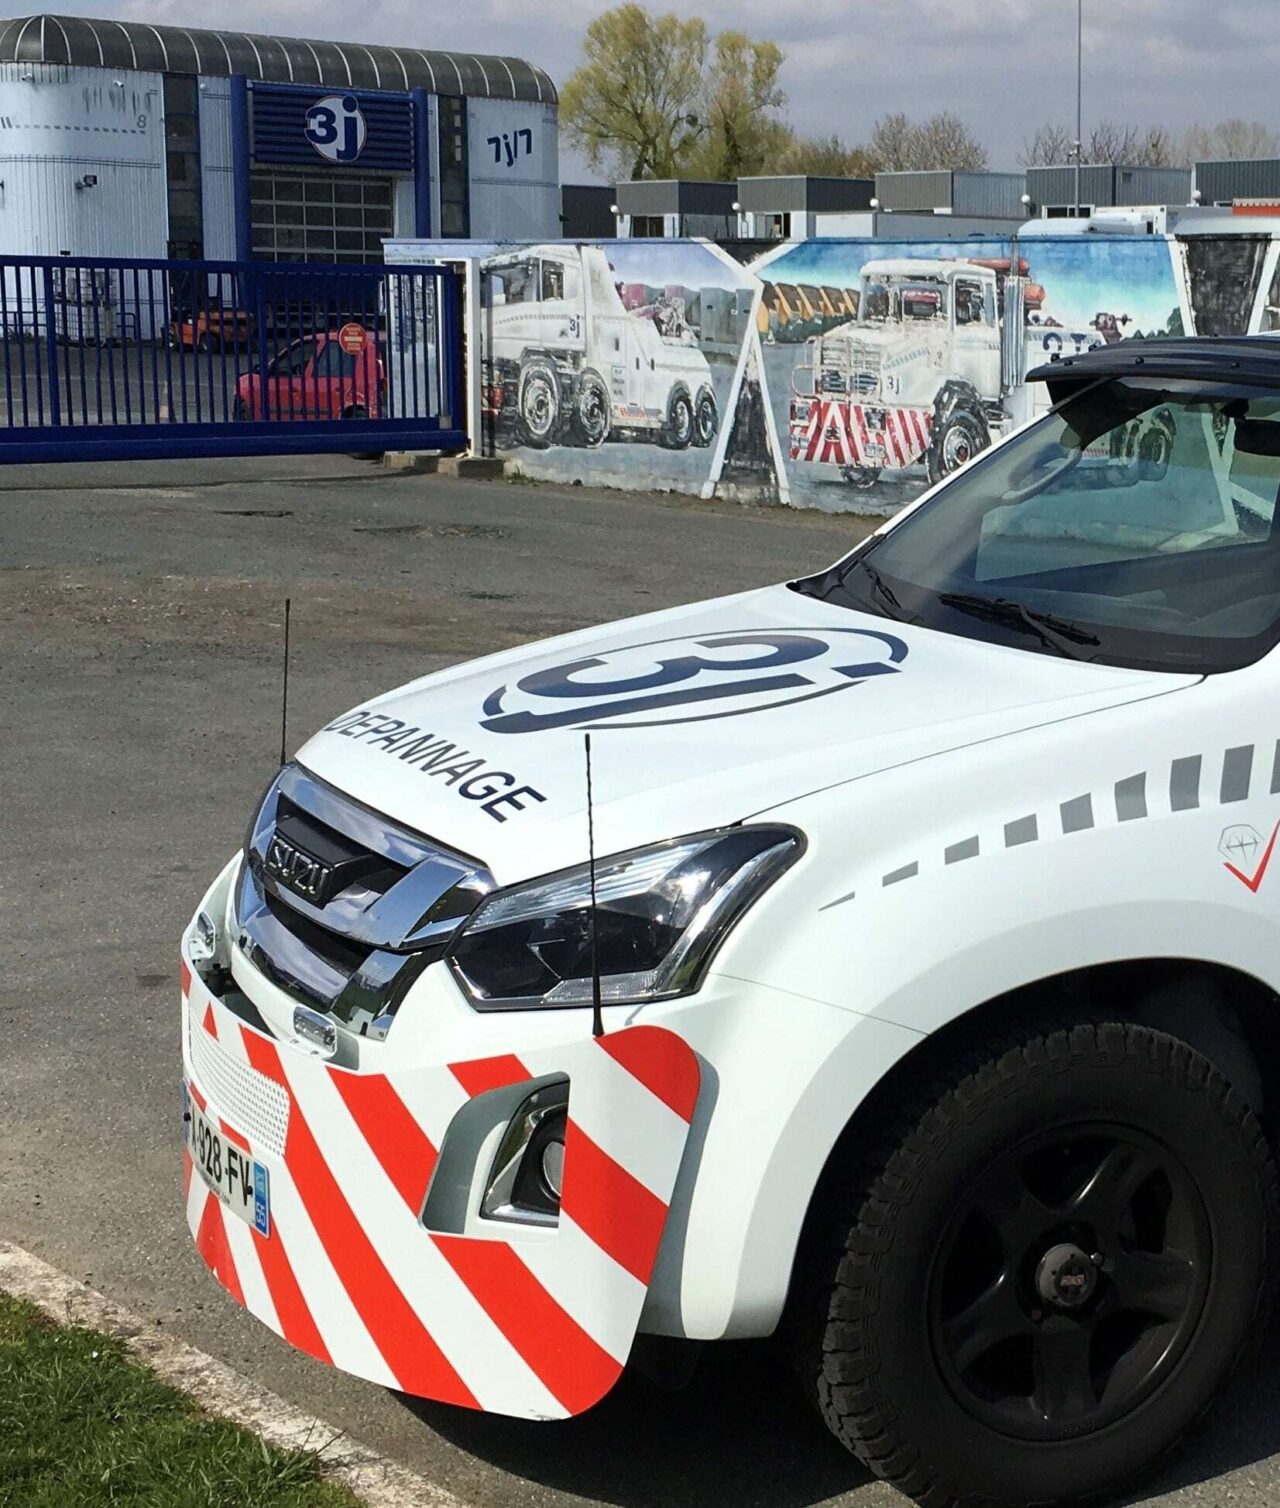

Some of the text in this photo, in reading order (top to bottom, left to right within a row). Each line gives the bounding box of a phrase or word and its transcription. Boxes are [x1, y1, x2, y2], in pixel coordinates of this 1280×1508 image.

[304, 94, 359, 161] 3j
[487, 128, 533, 167] 7j/7
[478, 634, 904, 735] 3j
[322, 710, 549, 824] DEPANNAGE
